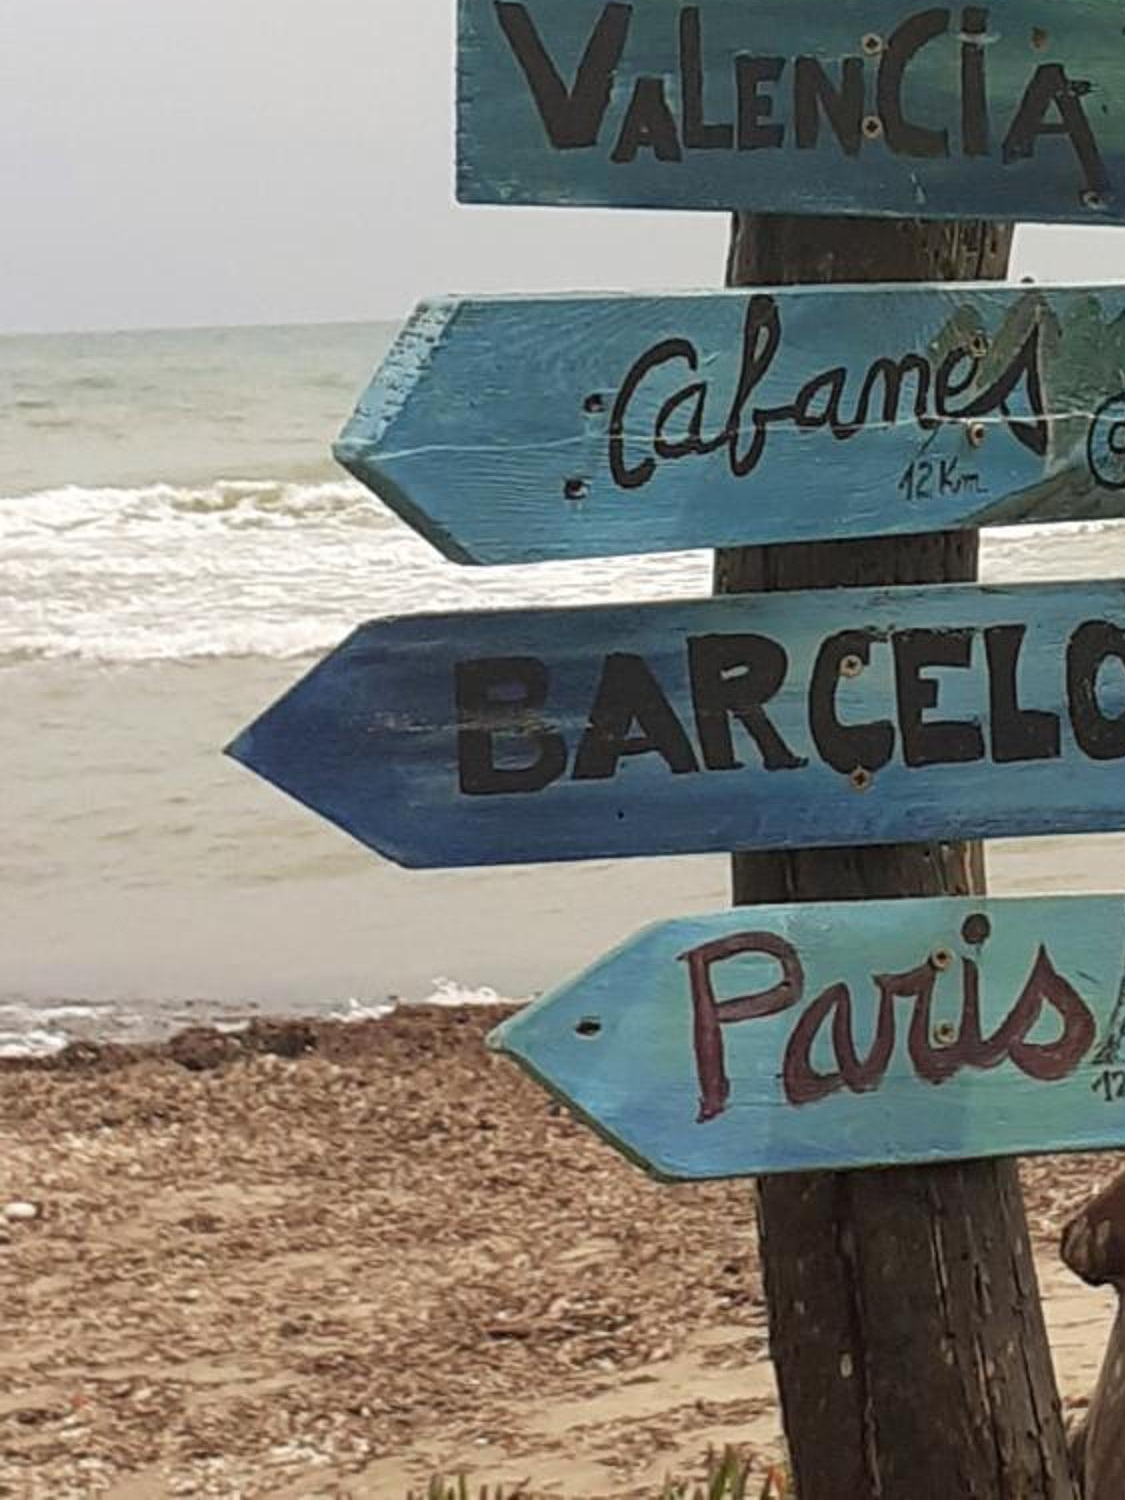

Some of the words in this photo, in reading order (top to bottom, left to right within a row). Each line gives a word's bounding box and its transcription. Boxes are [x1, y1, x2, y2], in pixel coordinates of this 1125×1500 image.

[493, 0, 1111, 203] VALENCIA
[605, 293, 1050, 489] Cabanes
[677, 913, 1097, 1123] Paris
